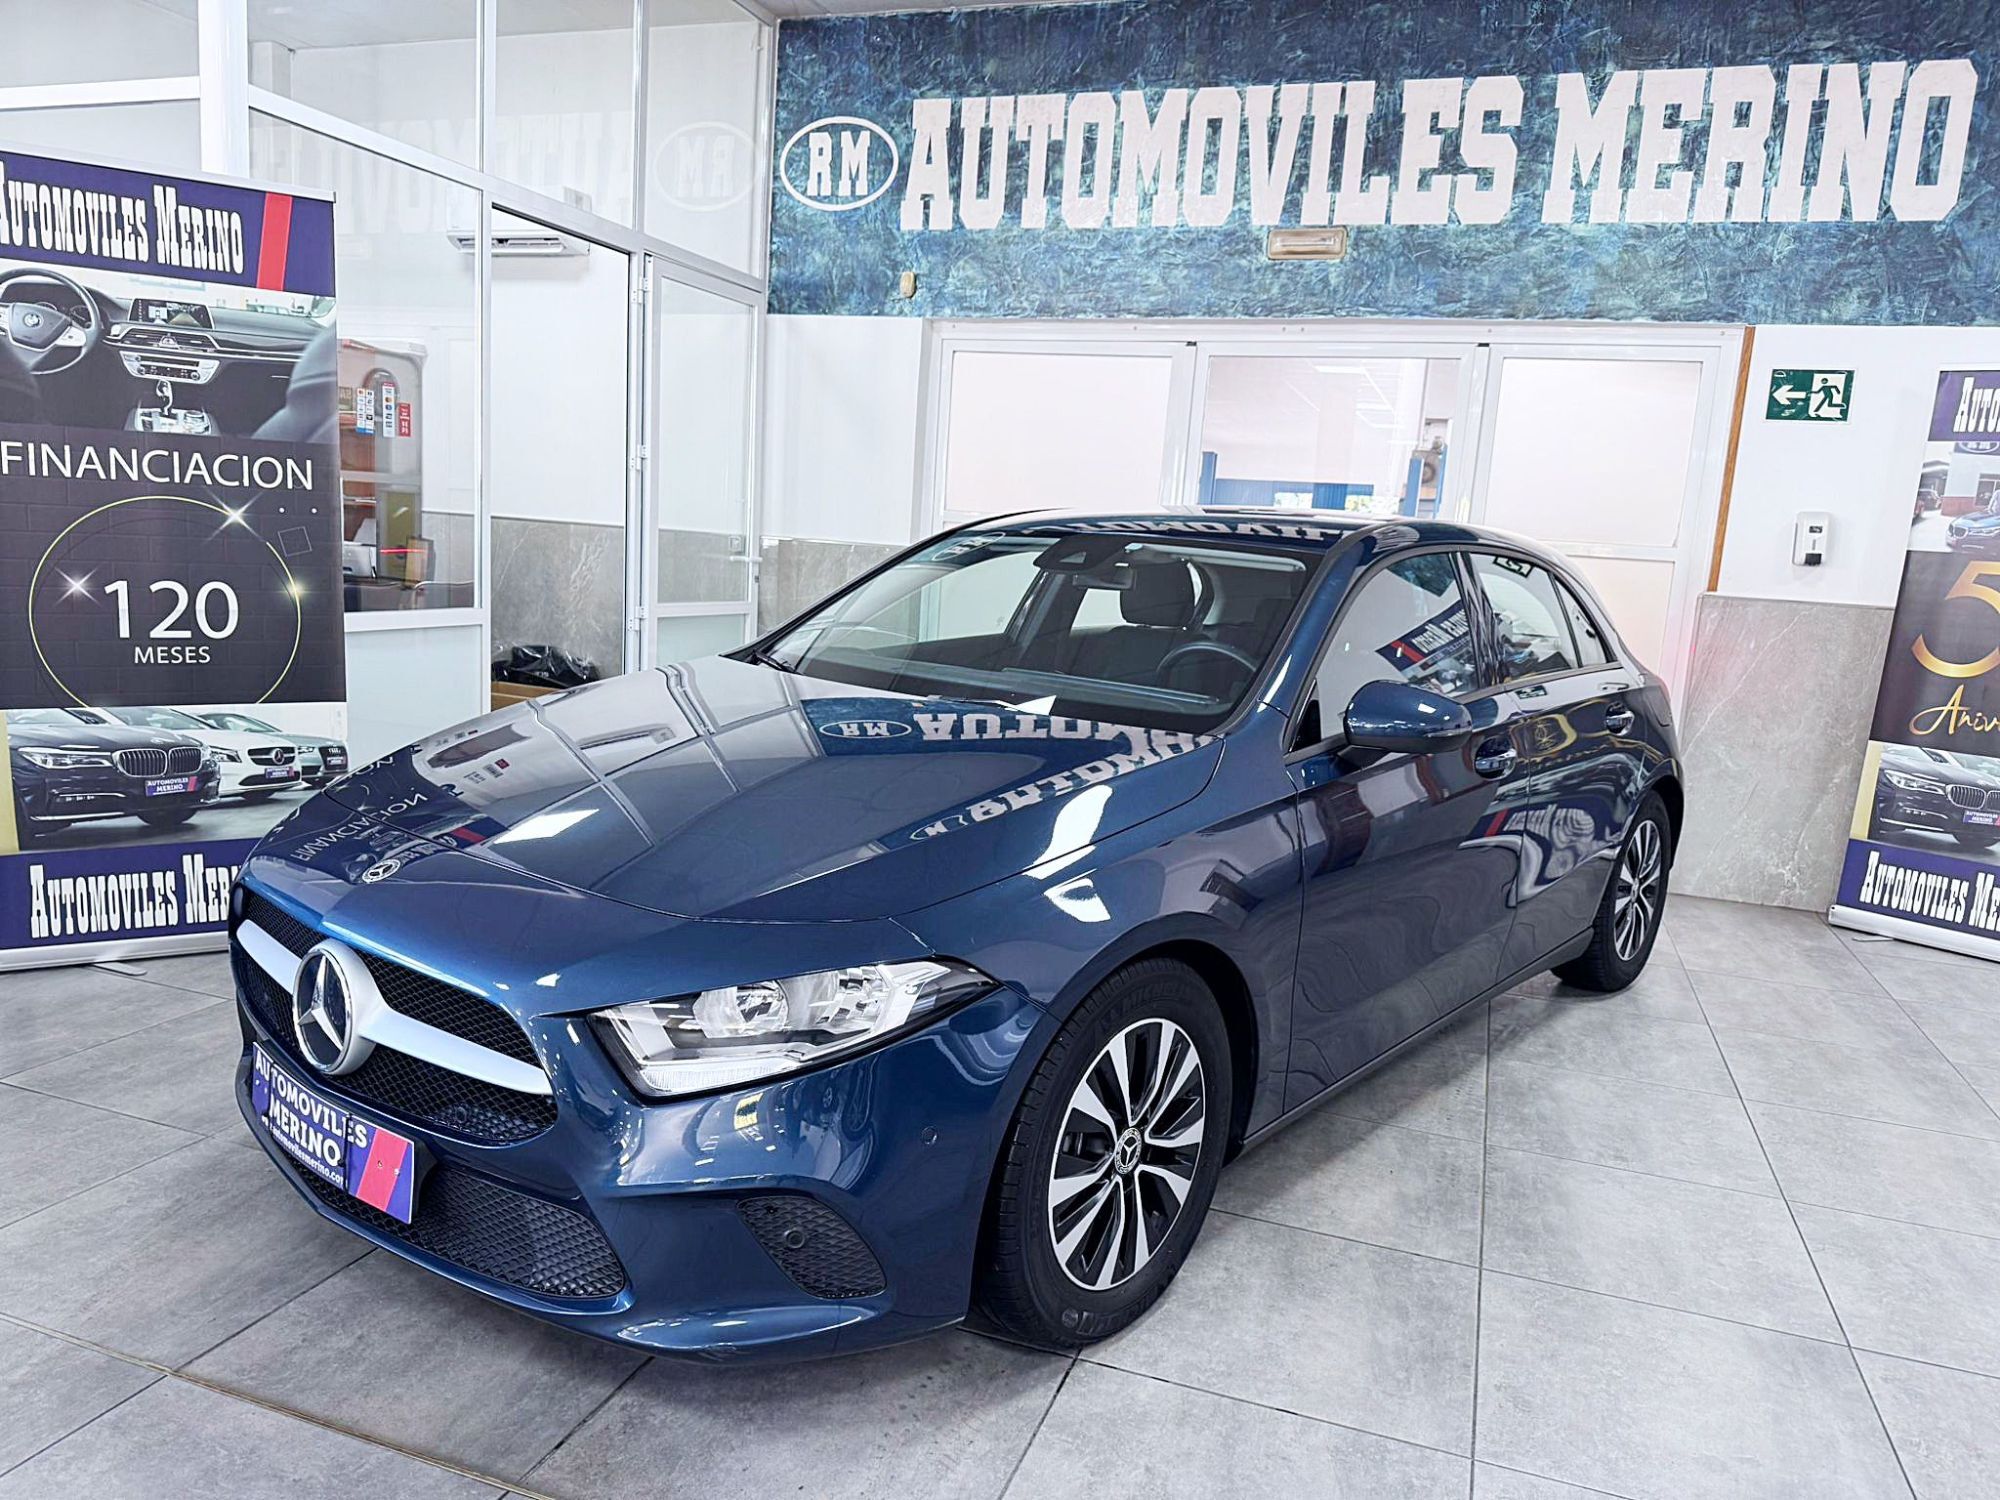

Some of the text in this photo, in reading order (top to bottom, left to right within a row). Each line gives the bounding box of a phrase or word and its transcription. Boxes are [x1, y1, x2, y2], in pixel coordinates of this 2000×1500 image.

[807, 130, 871, 196] RM
[900, 59, 1979, 231] AUTOMOVILES MERINO
[153, 184, 244, 275] MERINO
[1953, 376, 2000, 433] AUTO
[1, 440, 313, 490] FINANCIACION
[104, 580, 239, 639] 120
[134, 646, 211, 664] MESES
[1909, 684, 2000, 736] Aniv
[30, 853, 241, 939] AUTOMOVILES MER
[1860, 850, 1969, 923] AUTOMOVILES
[256, 1051, 367, 1148] AUTOMOVILES
[269, 1094, 341, 1167] MERINO
